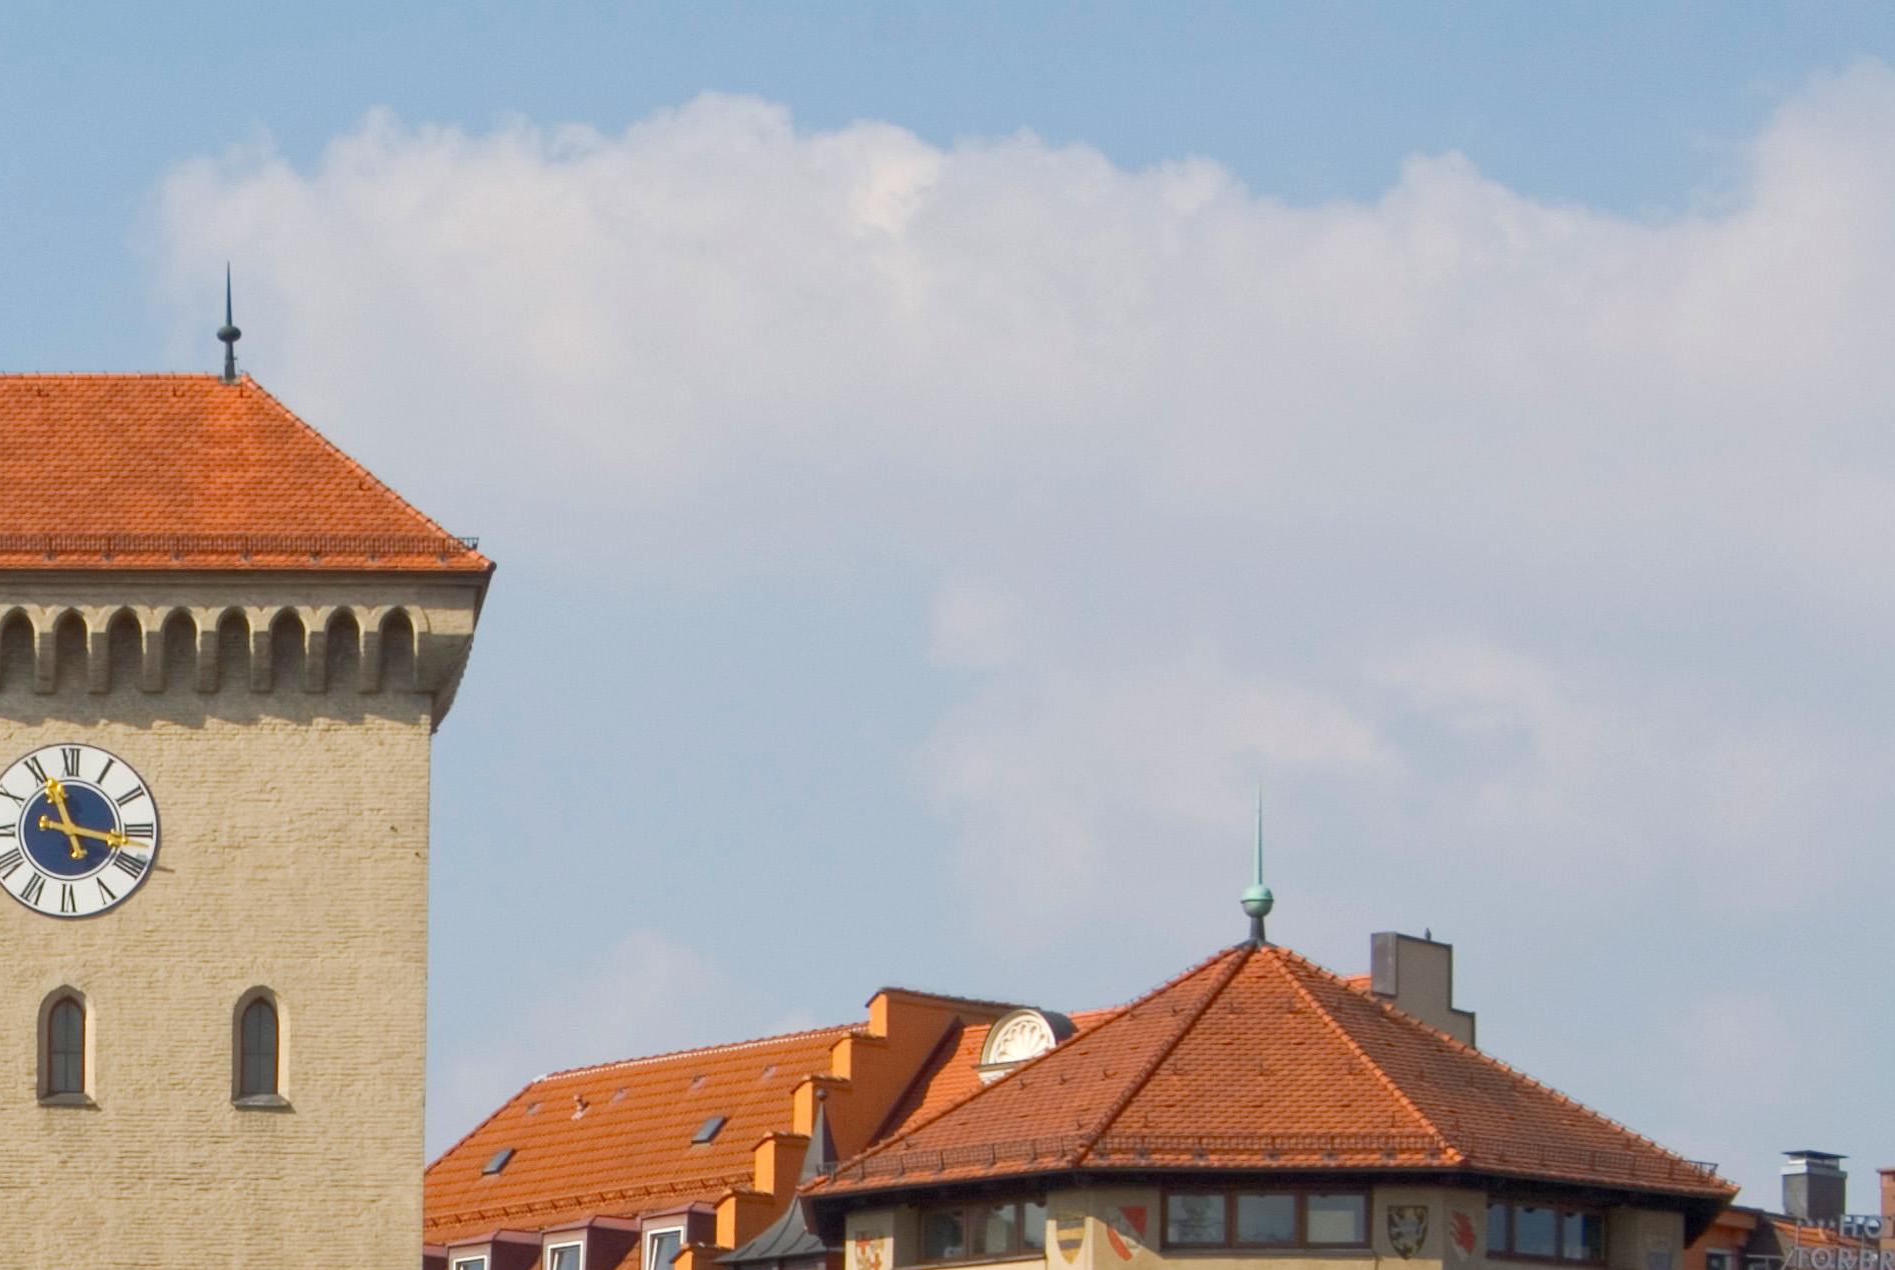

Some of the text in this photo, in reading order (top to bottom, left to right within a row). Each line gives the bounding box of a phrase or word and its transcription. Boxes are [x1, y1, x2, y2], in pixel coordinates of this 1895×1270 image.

[23, 756, 48, 787] XI
[61, 748, 81, 777] XII
[96, 757, 116, 784] I
[116, 785, 145, 807] II
[124, 822, 153, 839] III
[60, 884, 77, 913] VI
[96, 877, 117, 905] V
